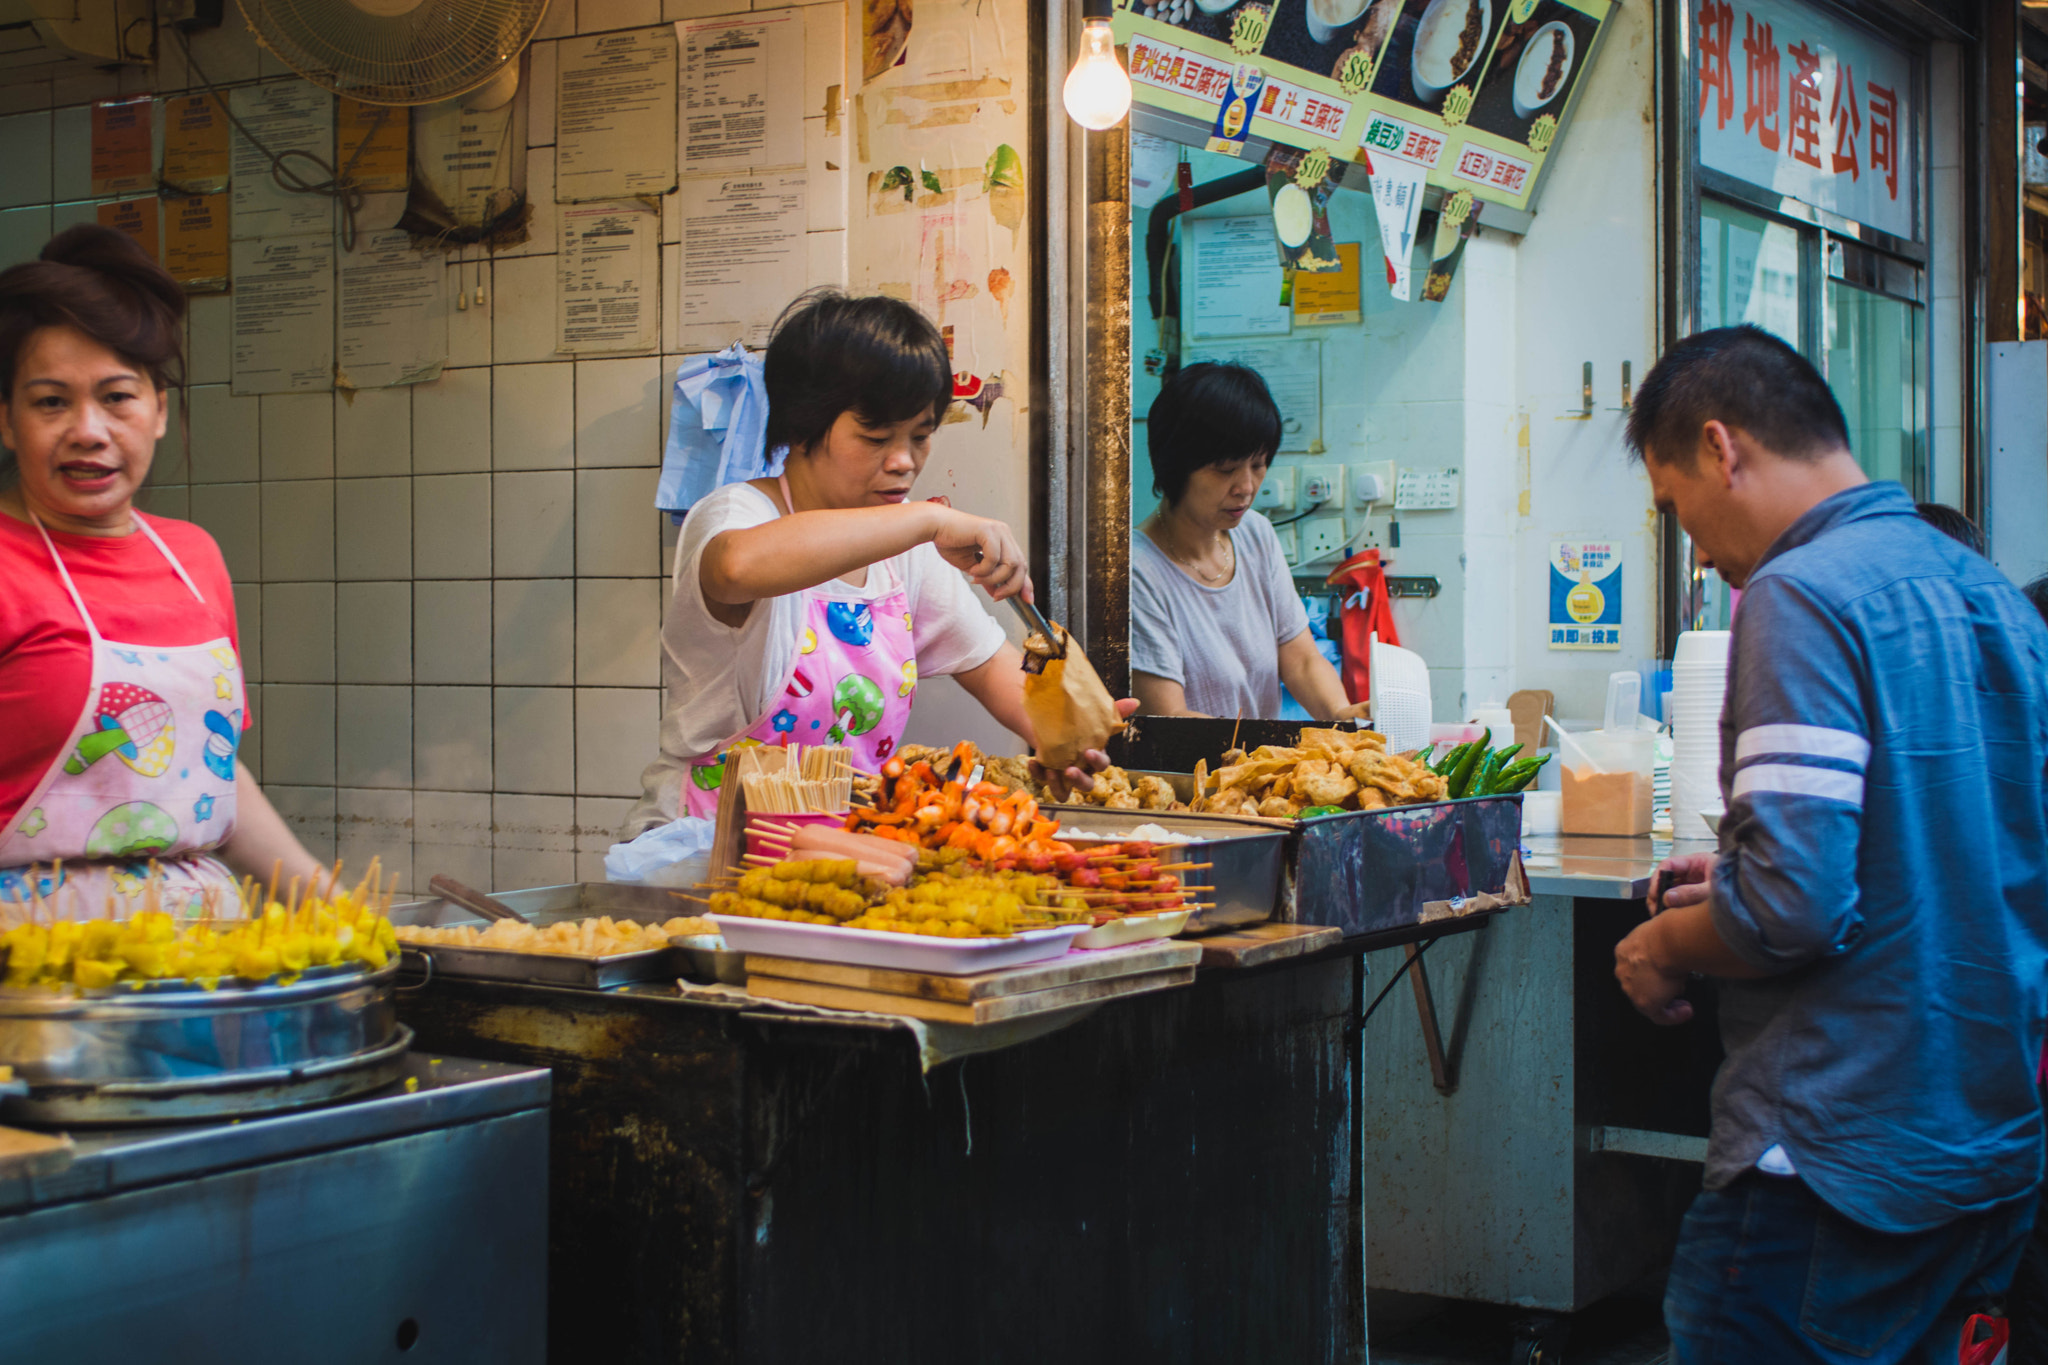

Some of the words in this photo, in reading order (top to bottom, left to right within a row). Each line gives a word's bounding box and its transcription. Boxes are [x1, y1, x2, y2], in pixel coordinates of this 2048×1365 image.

[1235, 15, 1263, 44] $10
[1345, 55, 1369, 87] $8
[1446, 92, 1469, 117] $10
[1531, 121, 1554, 144] $10
[1300, 156, 1327, 180] $10
[1448, 197, 1470, 219] $10
